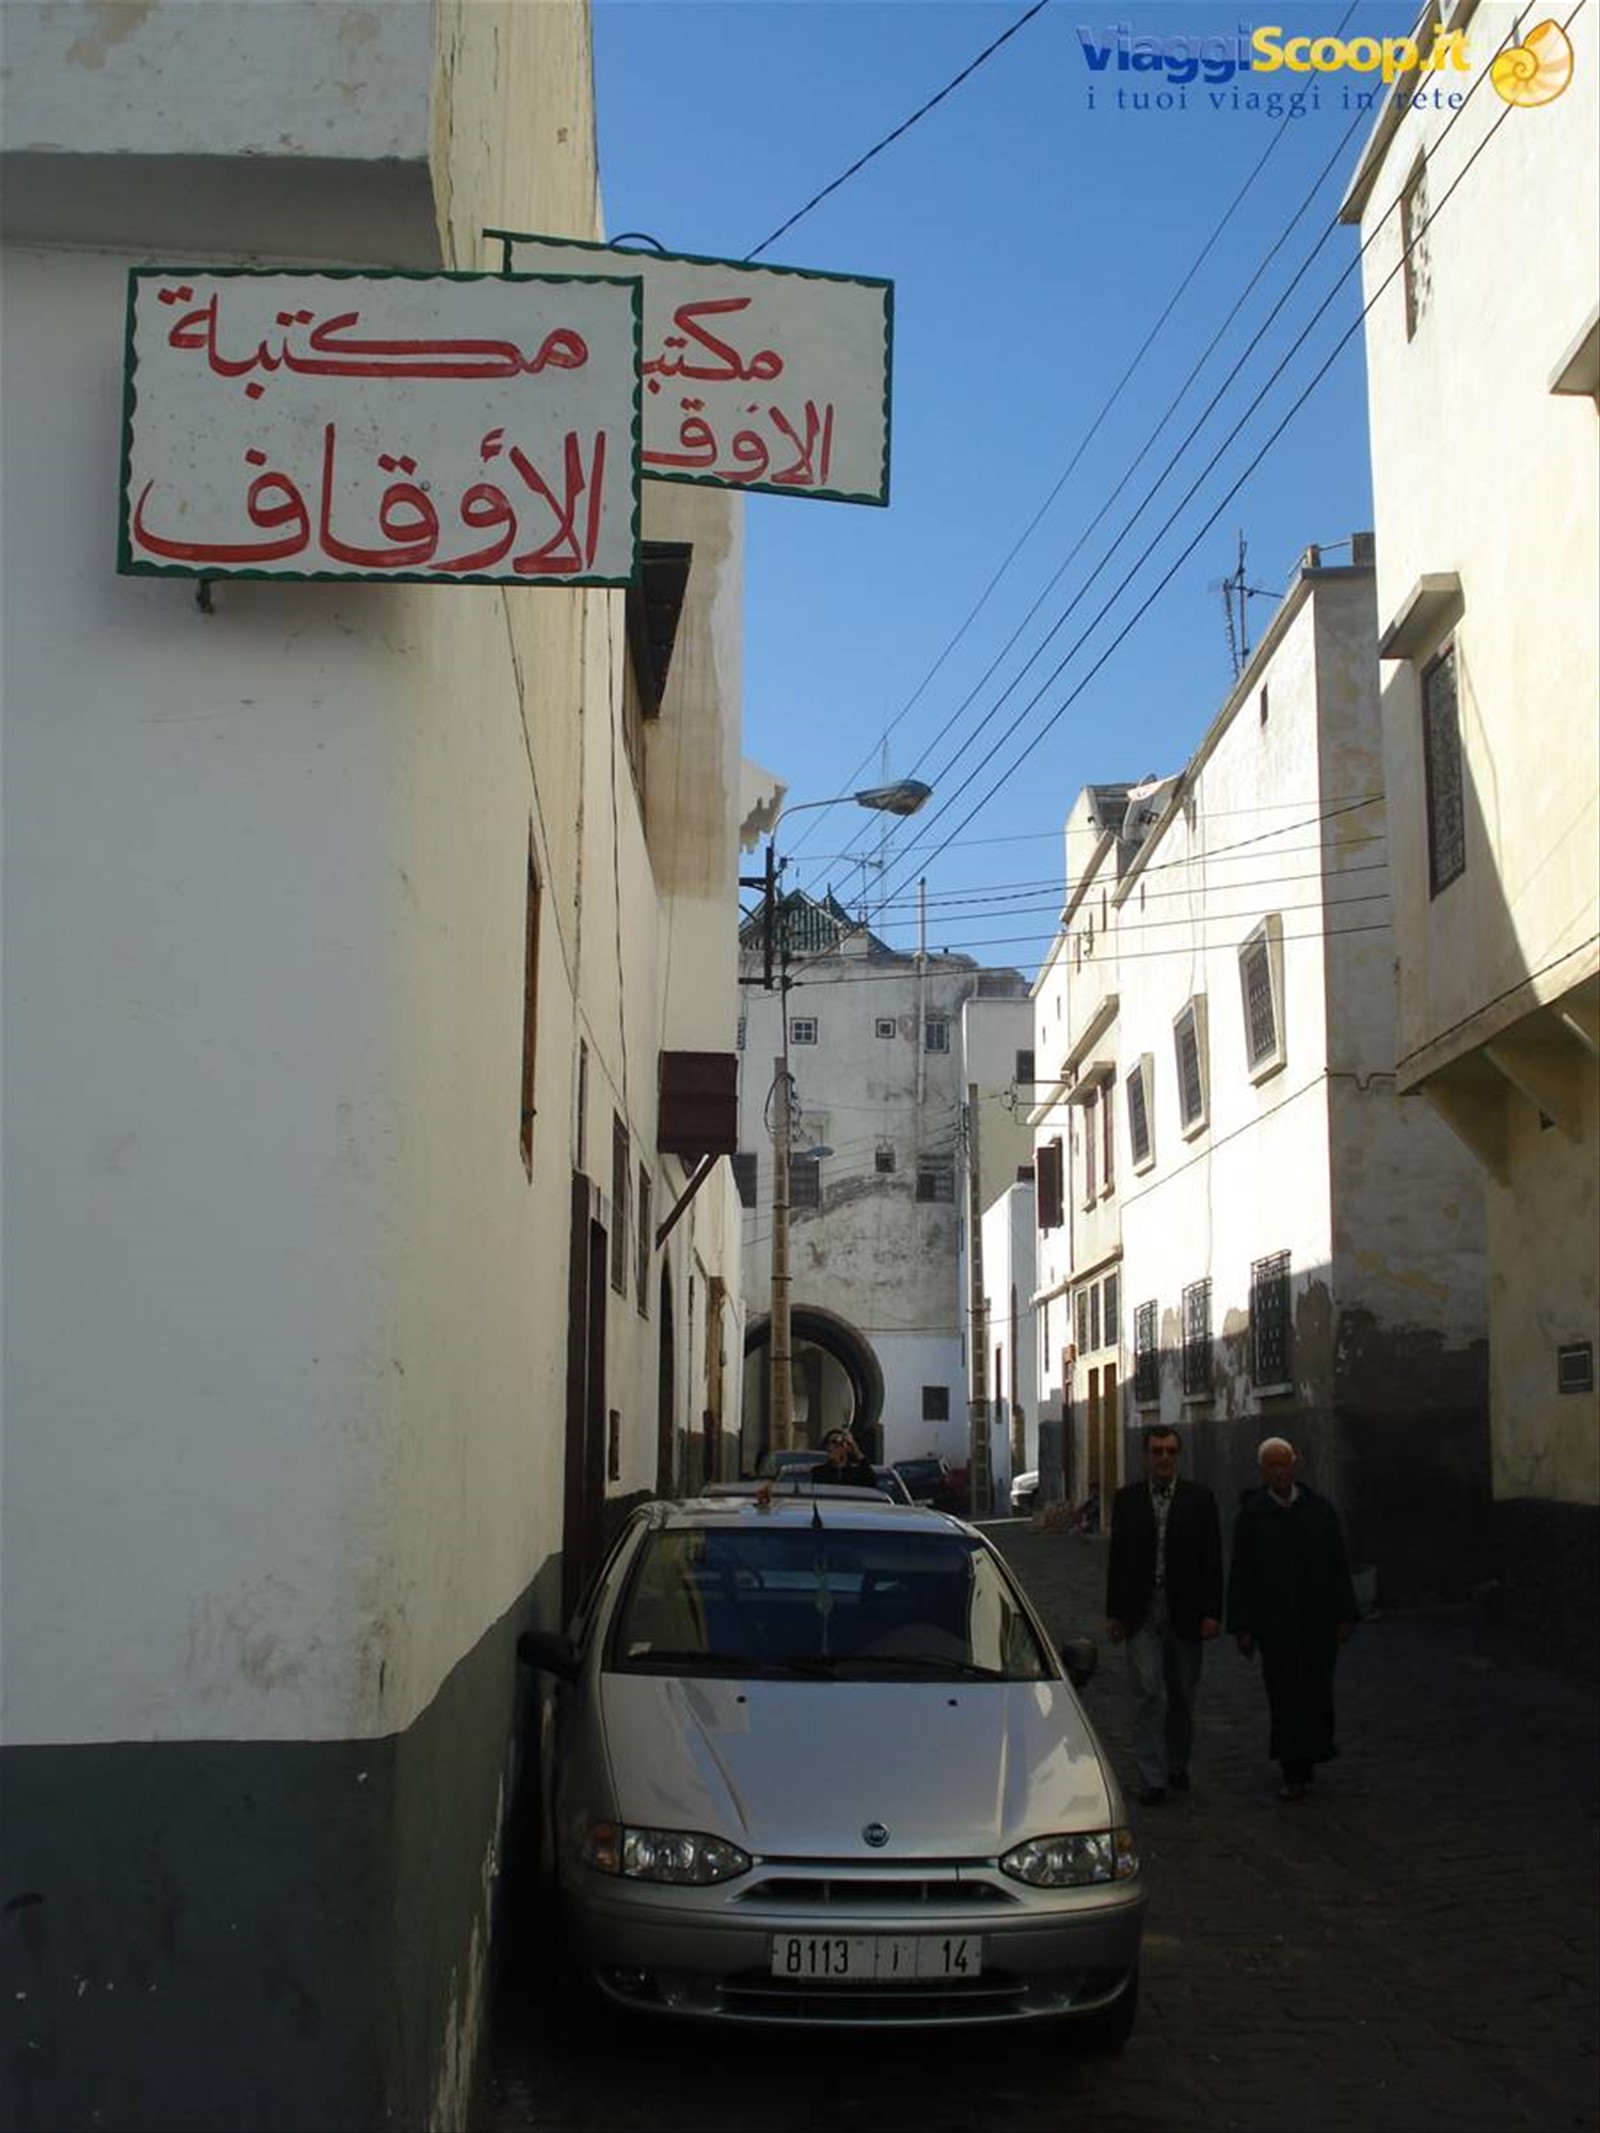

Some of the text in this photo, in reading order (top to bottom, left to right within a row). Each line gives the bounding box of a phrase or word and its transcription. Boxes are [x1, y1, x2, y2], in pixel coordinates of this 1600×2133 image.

[158, 284, 589, 399] مكتبة
[642, 296, 784, 395] مكتب
[133, 423, 606, 574] الأوقاف
[786, 1938, 849, 1974] 8113
[942, 1939, 968, 1974] 14
